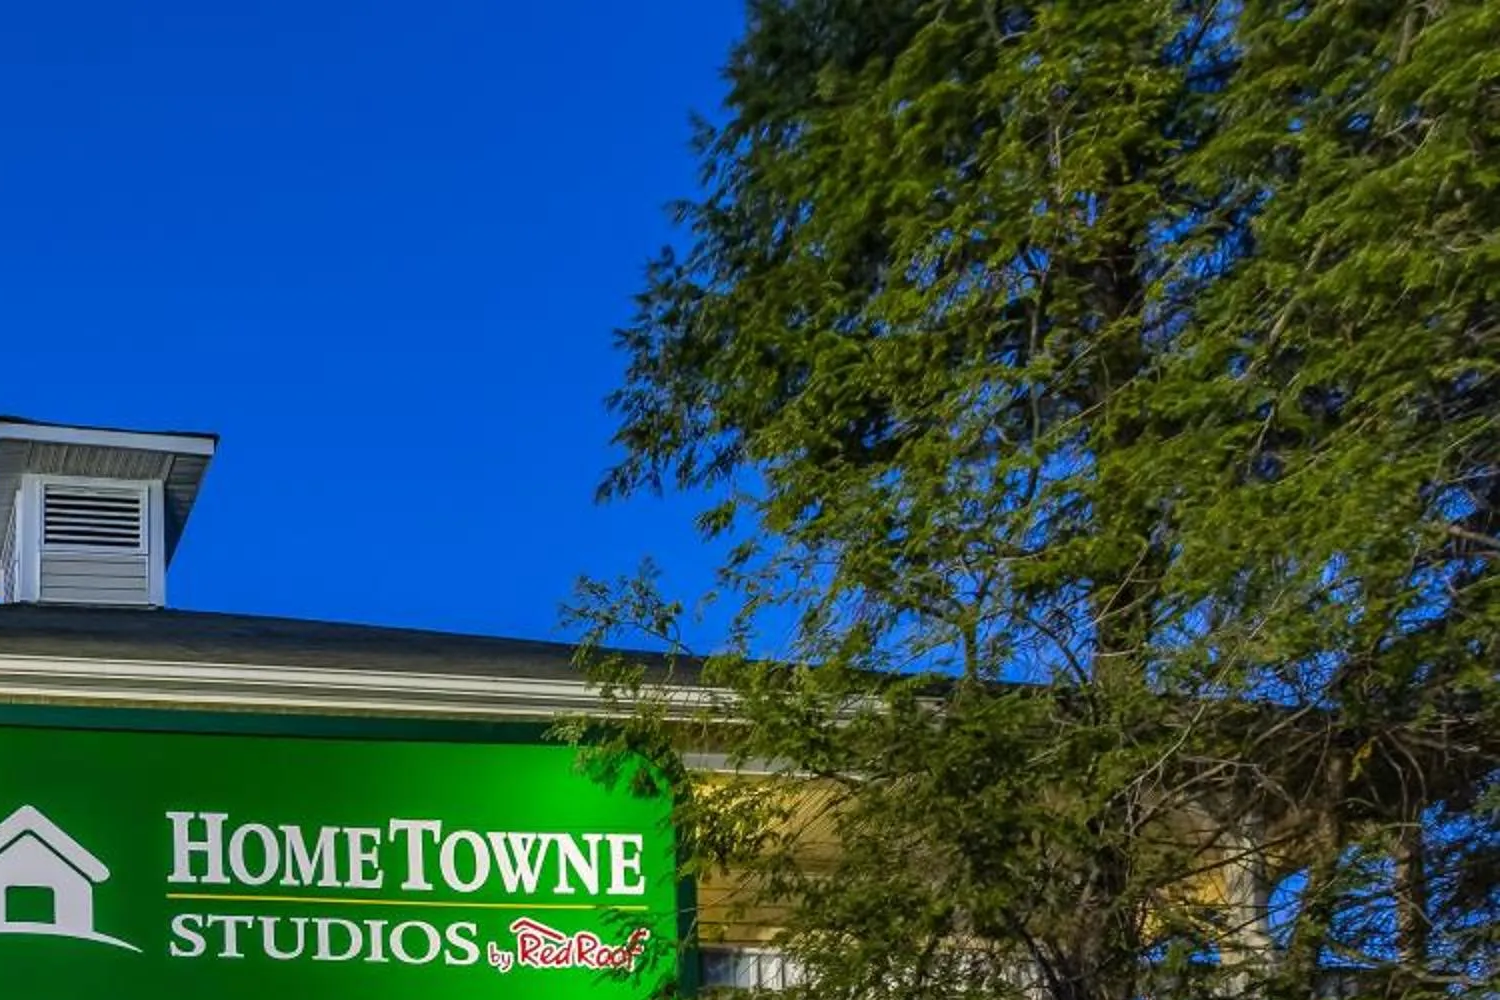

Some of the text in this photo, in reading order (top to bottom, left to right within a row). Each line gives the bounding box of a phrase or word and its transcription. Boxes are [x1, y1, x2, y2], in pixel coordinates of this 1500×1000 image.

[169, 912, 481, 965] STUDIOS
[488, 941, 514, 973] by
[518, 931, 574, 968] Red
